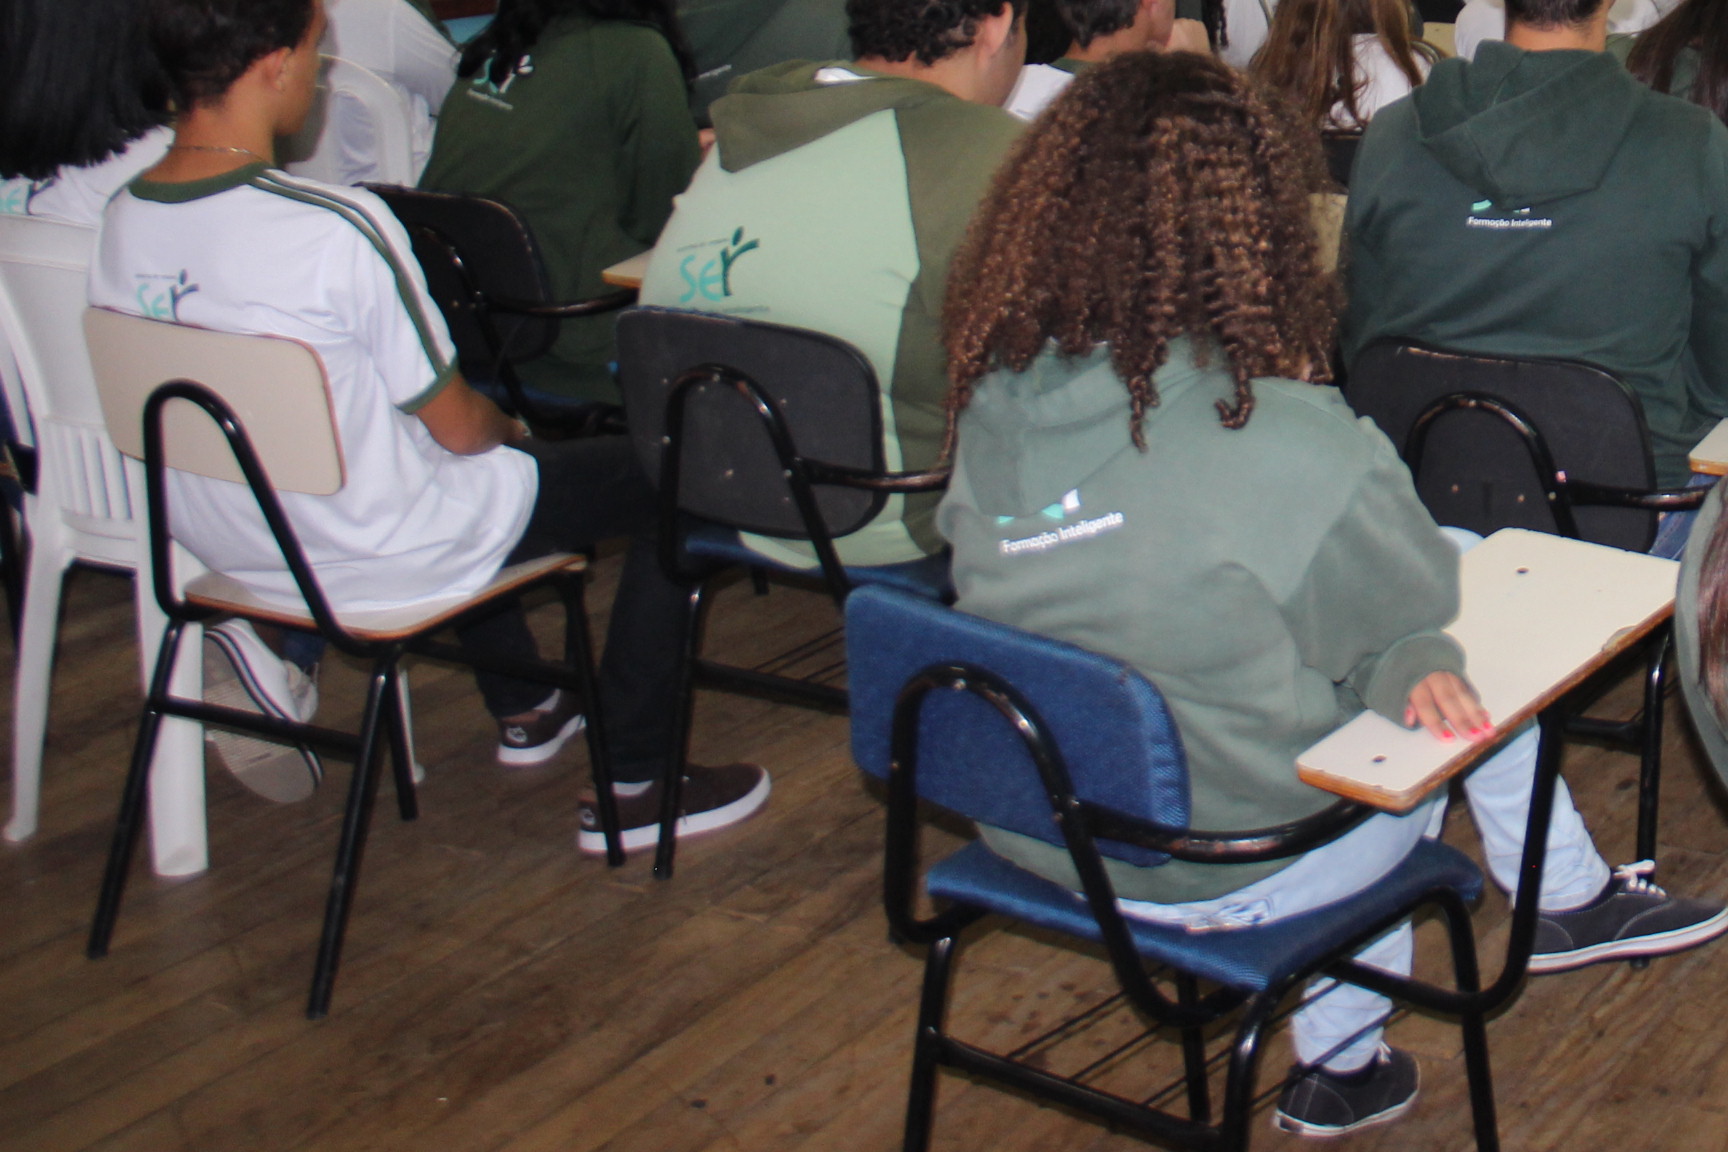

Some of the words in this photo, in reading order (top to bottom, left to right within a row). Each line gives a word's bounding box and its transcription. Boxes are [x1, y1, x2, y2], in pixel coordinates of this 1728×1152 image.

[1466, 216, 1511, 228] Formação
[1000, 531, 1060, 554] Formação
[1058, 511, 1125, 541] Inteligente
